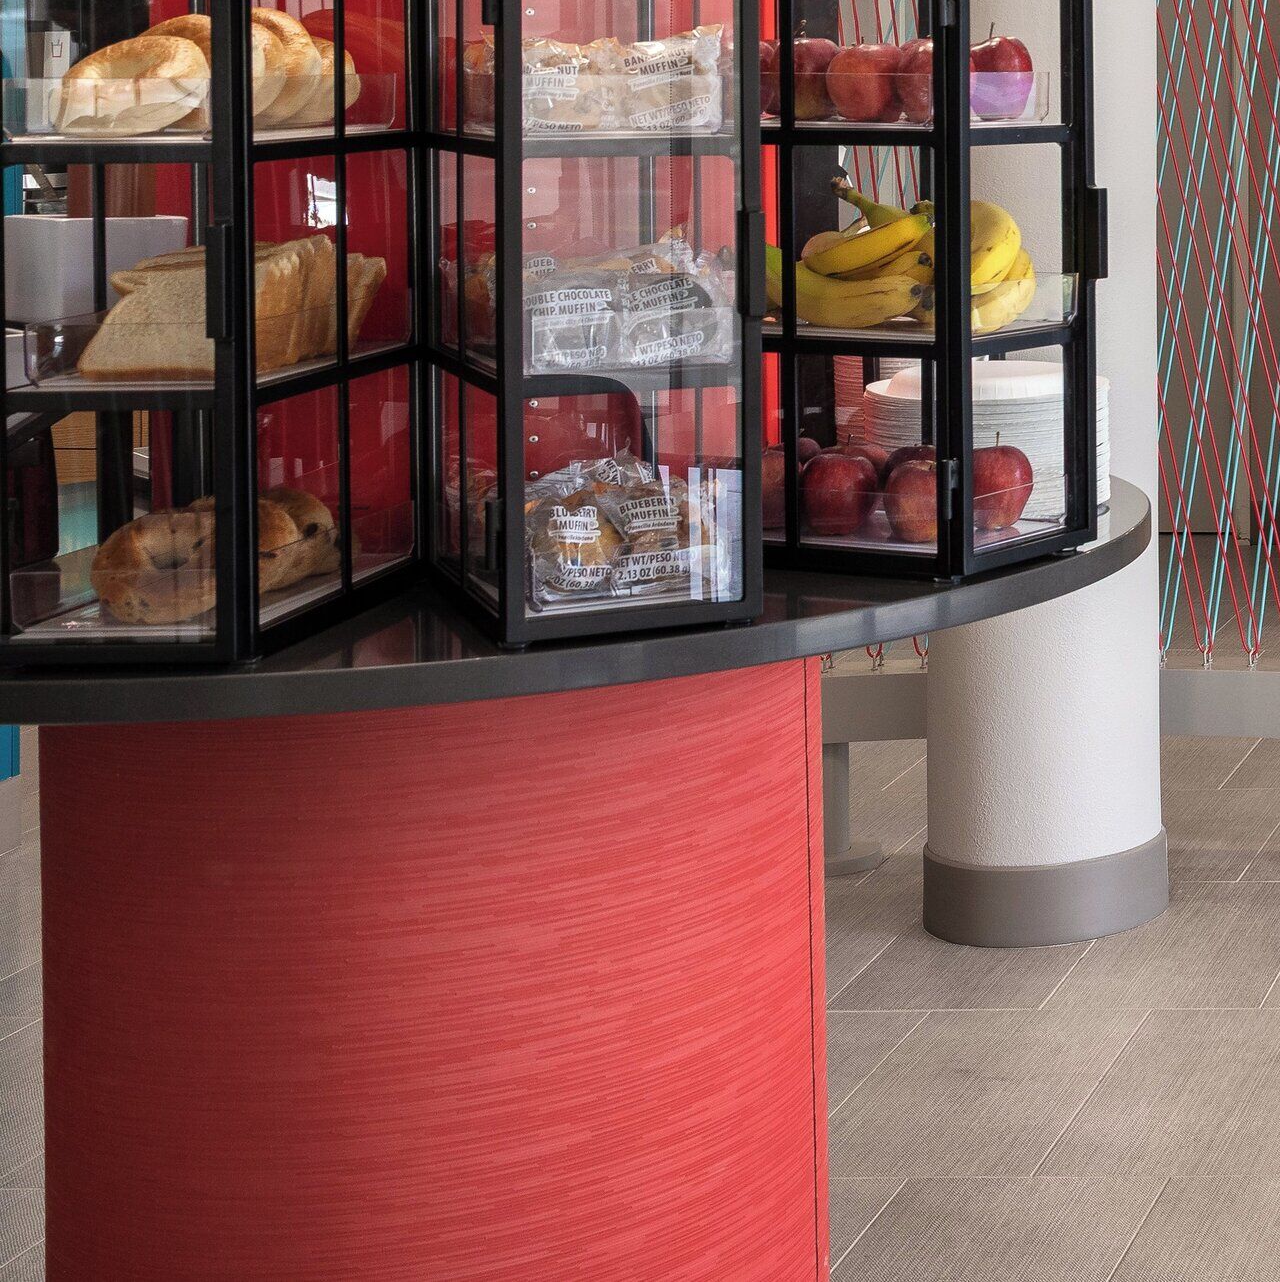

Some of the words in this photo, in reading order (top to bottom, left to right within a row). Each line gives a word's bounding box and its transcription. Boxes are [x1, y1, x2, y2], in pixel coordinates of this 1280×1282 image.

[557, 65, 577, 75] NUT
[639, 59, 679, 76] MUFFIN
[639, 277, 692, 299] CHOCOLATE
[558, 290, 610, 302] CHOCOLATE
[642, 291, 679, 309] MUFFIN
[559, 301, 596, 315] MUFFIN
[630, 508, 669, 520] MUFFIN
[559, 520, 588, 531] MUFFIN
[632, 552, 671, 565] WT/PESO
[589, 567, 612, 577] NETO
[618, 569, 638, 581] 2.13
[639, 567, 651, 578] OZ
[652, 564, 680, 577] (60.38
